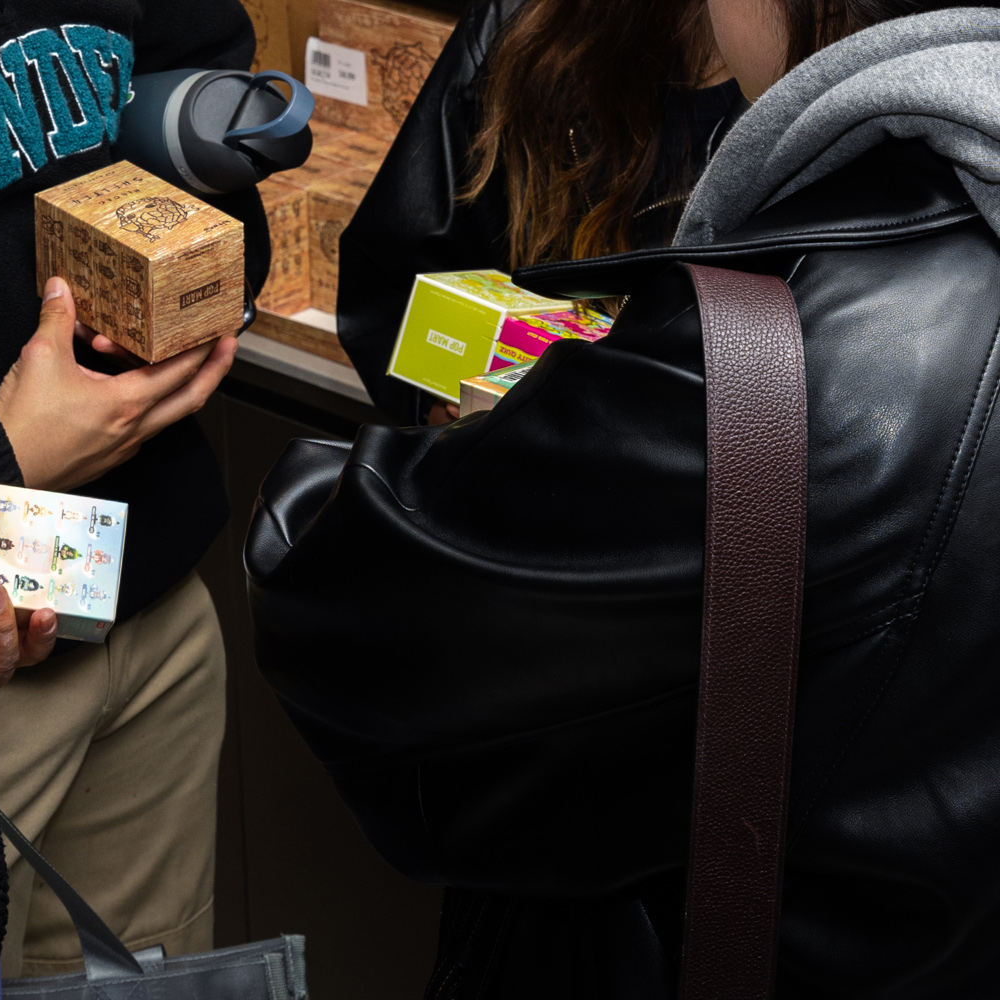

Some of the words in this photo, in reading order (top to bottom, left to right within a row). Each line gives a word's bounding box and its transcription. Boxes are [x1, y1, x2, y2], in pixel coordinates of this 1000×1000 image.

[203, 282, 220, 298] POP
[181, 290, 203, 307] MART
[429, 331, 449, 348] MART
[449, 341, 465, 354] POP
[500, 346, 517, 357] QUIZ
